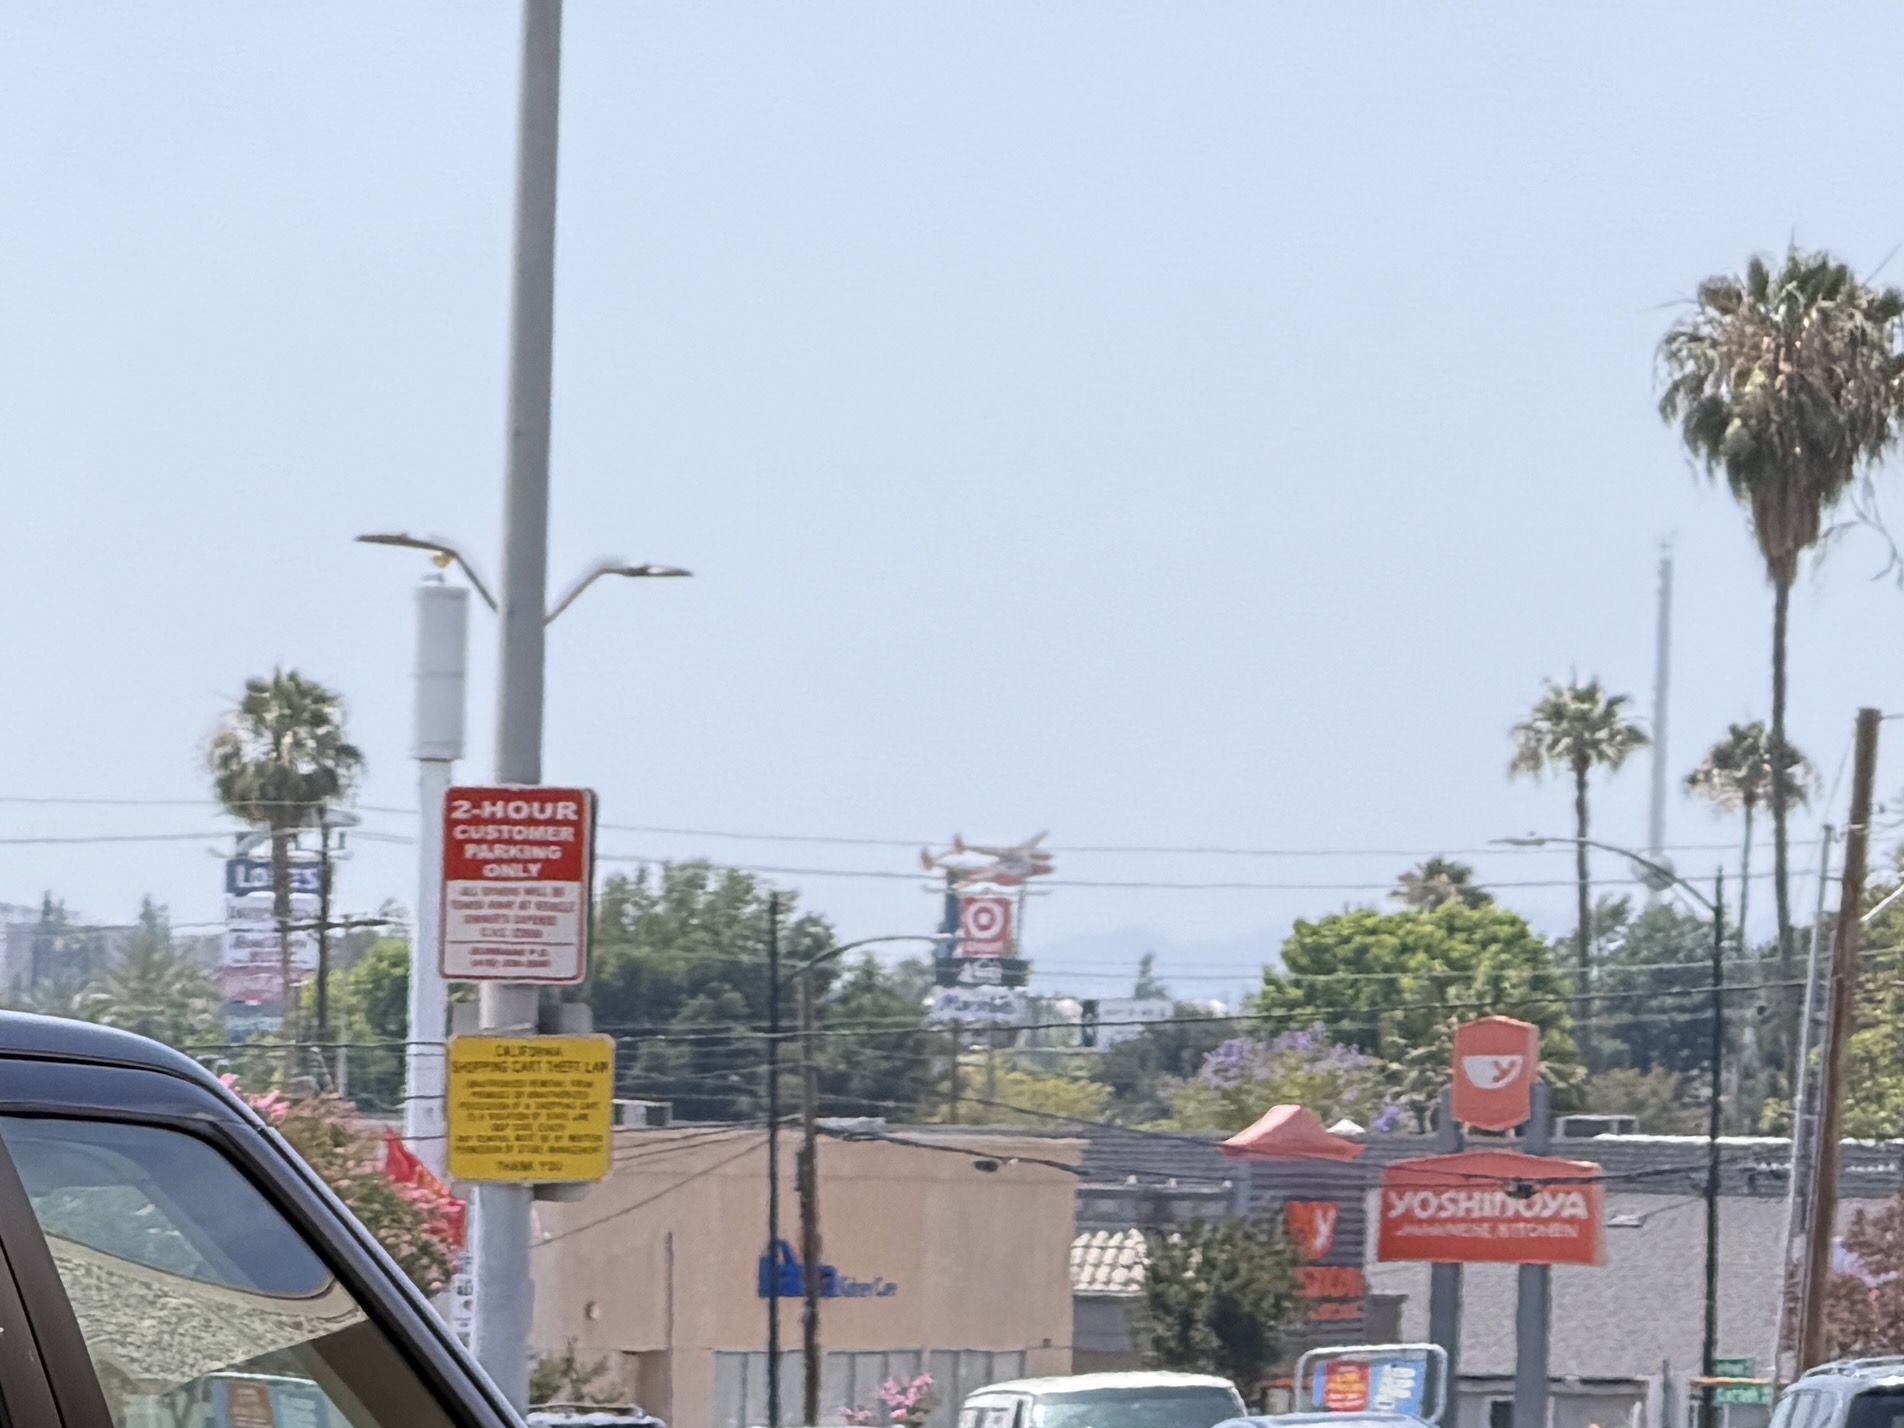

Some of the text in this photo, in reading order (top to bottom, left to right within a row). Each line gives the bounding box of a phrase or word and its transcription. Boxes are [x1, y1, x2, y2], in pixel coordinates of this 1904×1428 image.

[450, 800, 578, 820] 2-HOUR
[453, 825, 575, 841] CUSTOMER
[464, 843, 562, 860] PARKING
[482, 862, 542, 877] ONLY
[511, 1060, 542, 1073] CART
